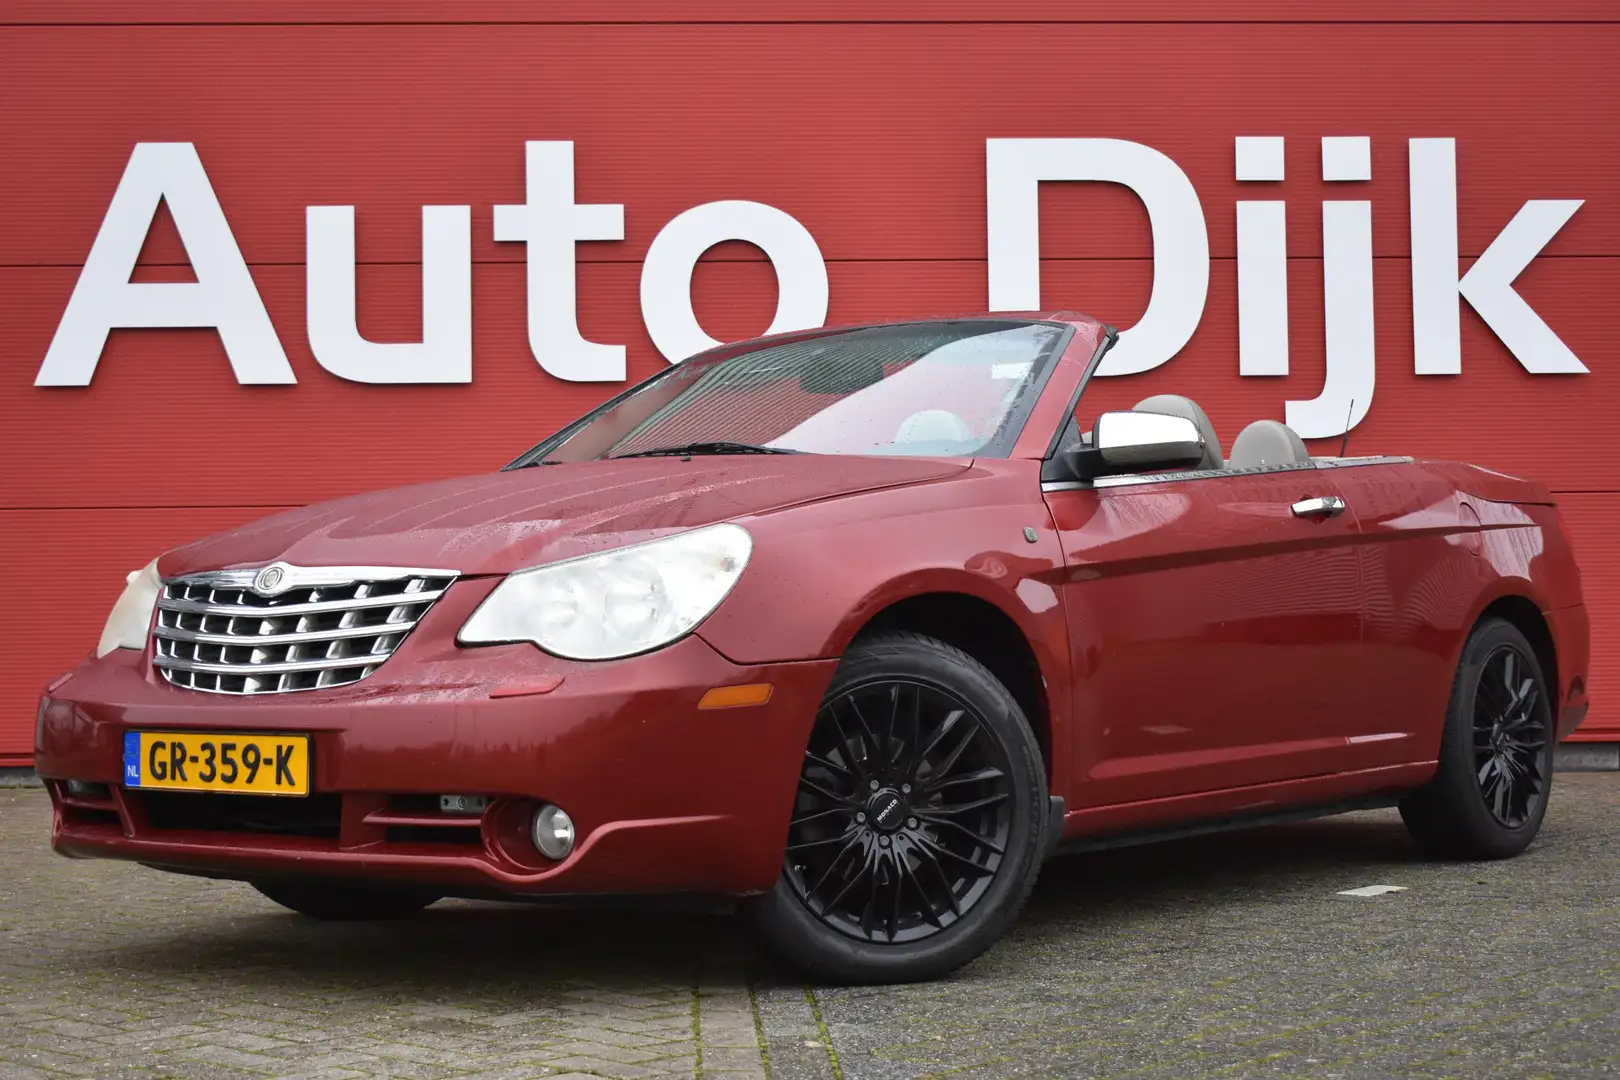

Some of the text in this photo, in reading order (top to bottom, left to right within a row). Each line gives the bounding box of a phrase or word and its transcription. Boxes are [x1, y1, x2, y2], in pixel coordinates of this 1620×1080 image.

[34, 136, 1590, 440] Auto Dijk
[127, 765, 140, 778] NL
[149, 740, 296, 787] GR-359-K
[876, 798, 898, 821] MONACO
